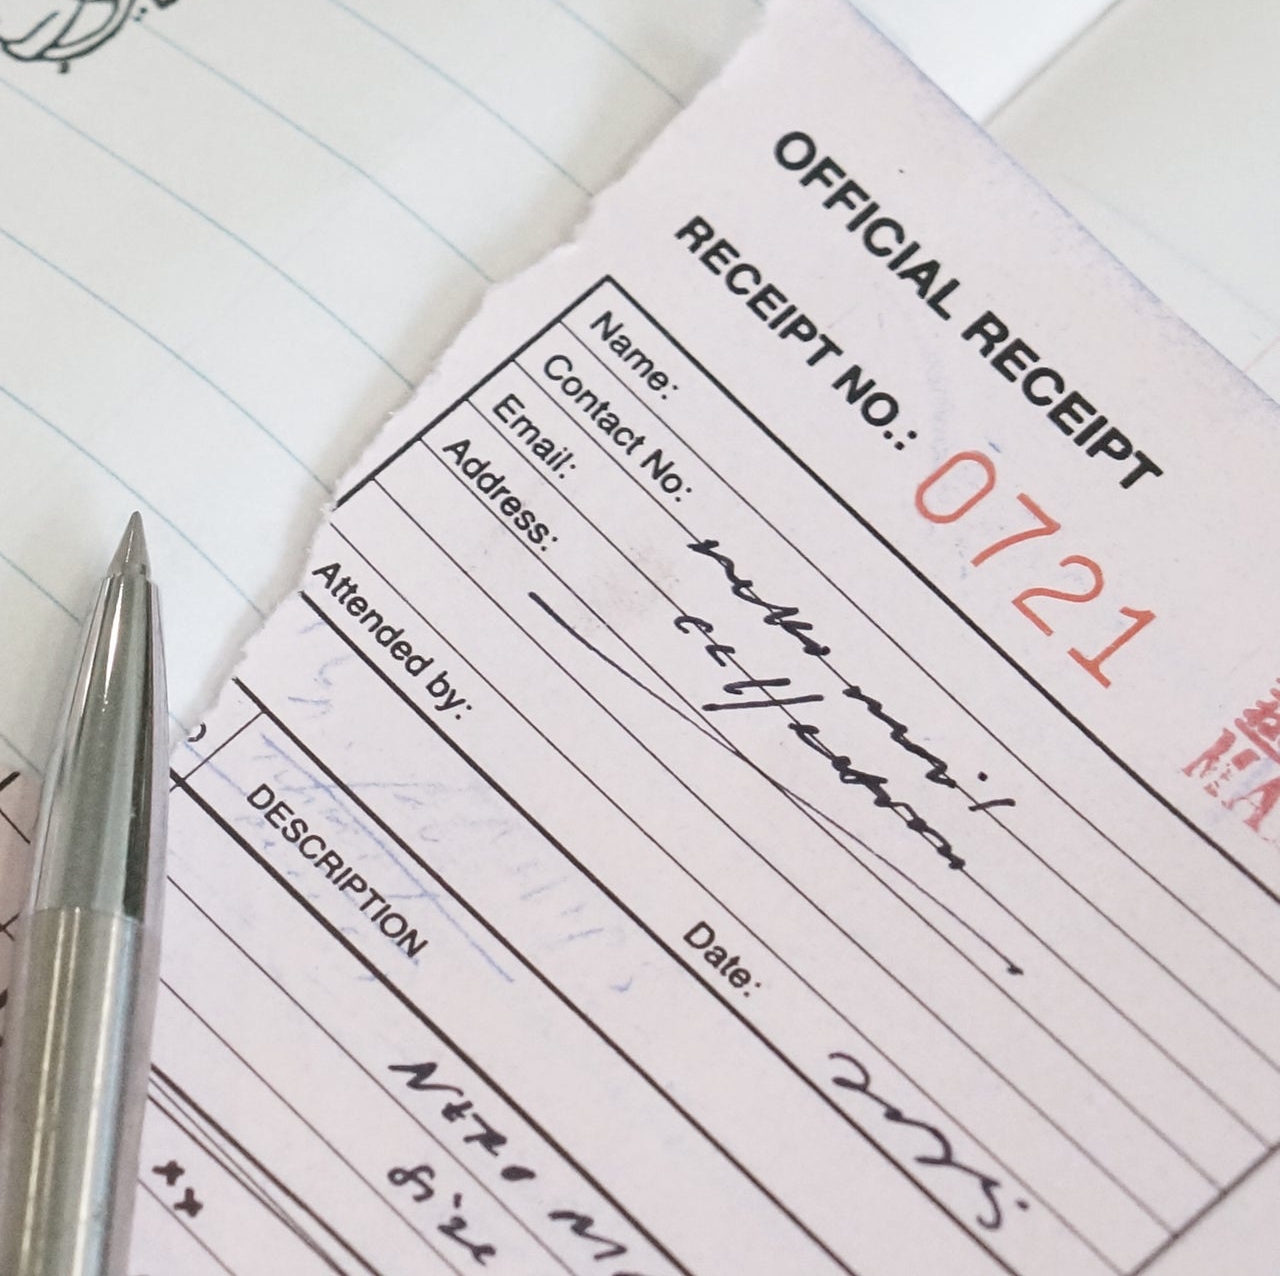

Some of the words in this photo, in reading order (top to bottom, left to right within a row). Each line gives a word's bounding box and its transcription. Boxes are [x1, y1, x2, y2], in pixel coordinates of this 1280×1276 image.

[590, 310, 679, 400] Name:
[774, 131, 960, 321] OFFICIAL
[960, 311, 1164, 489] RECEIPT
[442, 438, 558, 551] Address:
[492, 393, 576, 479] Email:
[543, 354, 646, 455] Contact
[640, 448, 692, 502] No:
[674, 215, 844, 366] RECEIPT
[832, 364, 917, 450] NO.:
[915, 451, 1156, 688] 0721
[312, 562, 434, 677] Attended
[425, 670, 473, 720] by:
[247, 783, 429, 959] DESCRIPTION
[682, 920, 761, 998] Date:
